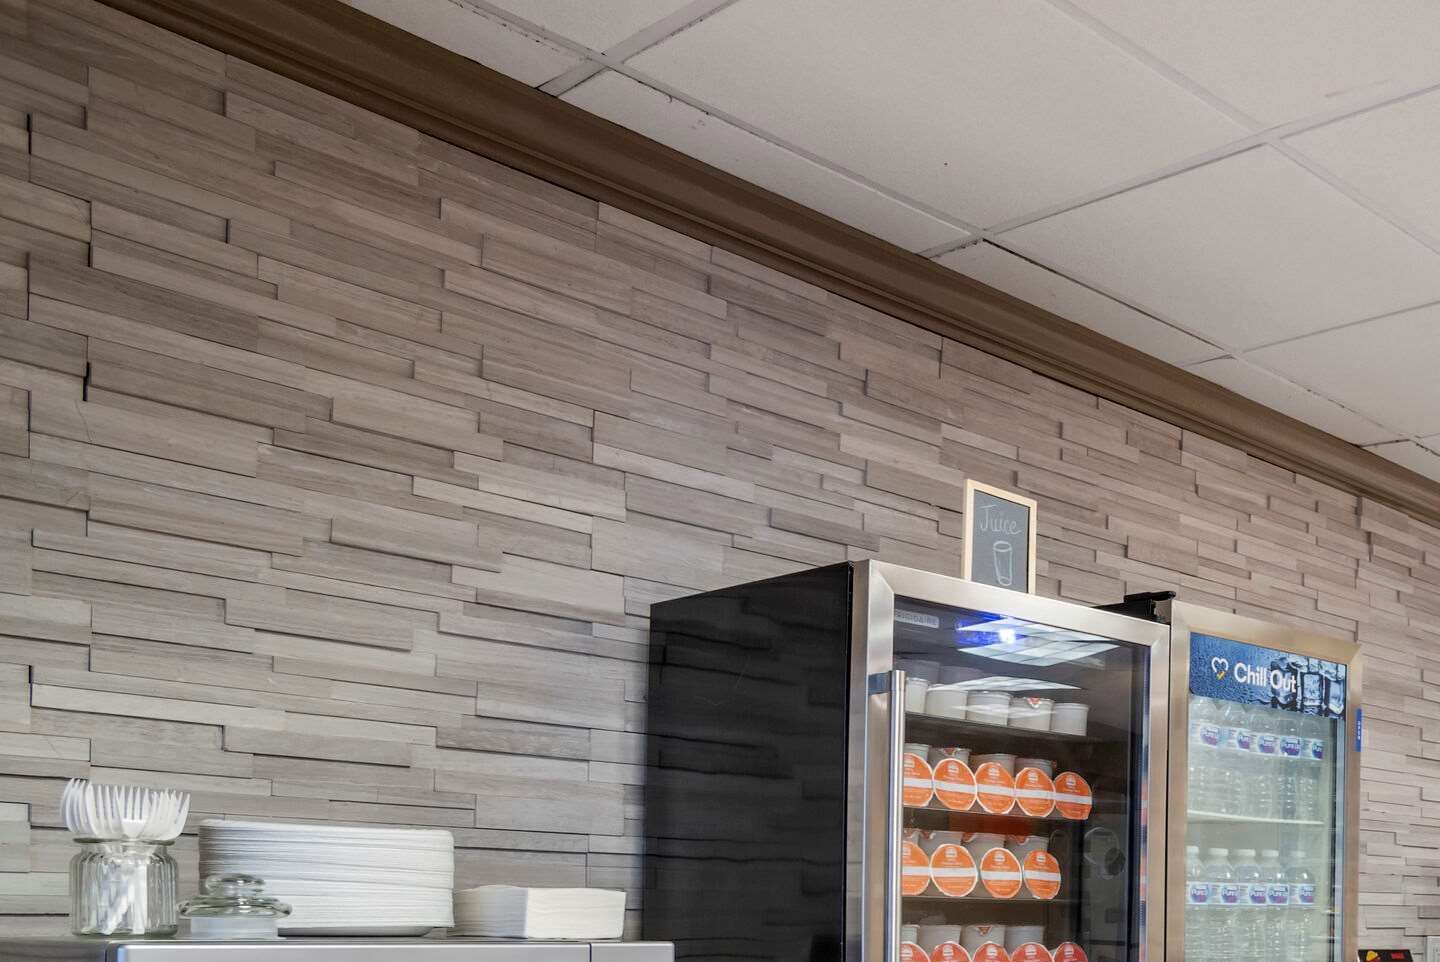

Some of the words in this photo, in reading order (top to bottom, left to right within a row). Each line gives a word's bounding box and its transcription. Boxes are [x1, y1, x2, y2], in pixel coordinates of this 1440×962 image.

[978, 504, 1022, 535] Juice
[1234, 662, 1267, 687] Chill
[1270, 669, 1297, 693] Out
